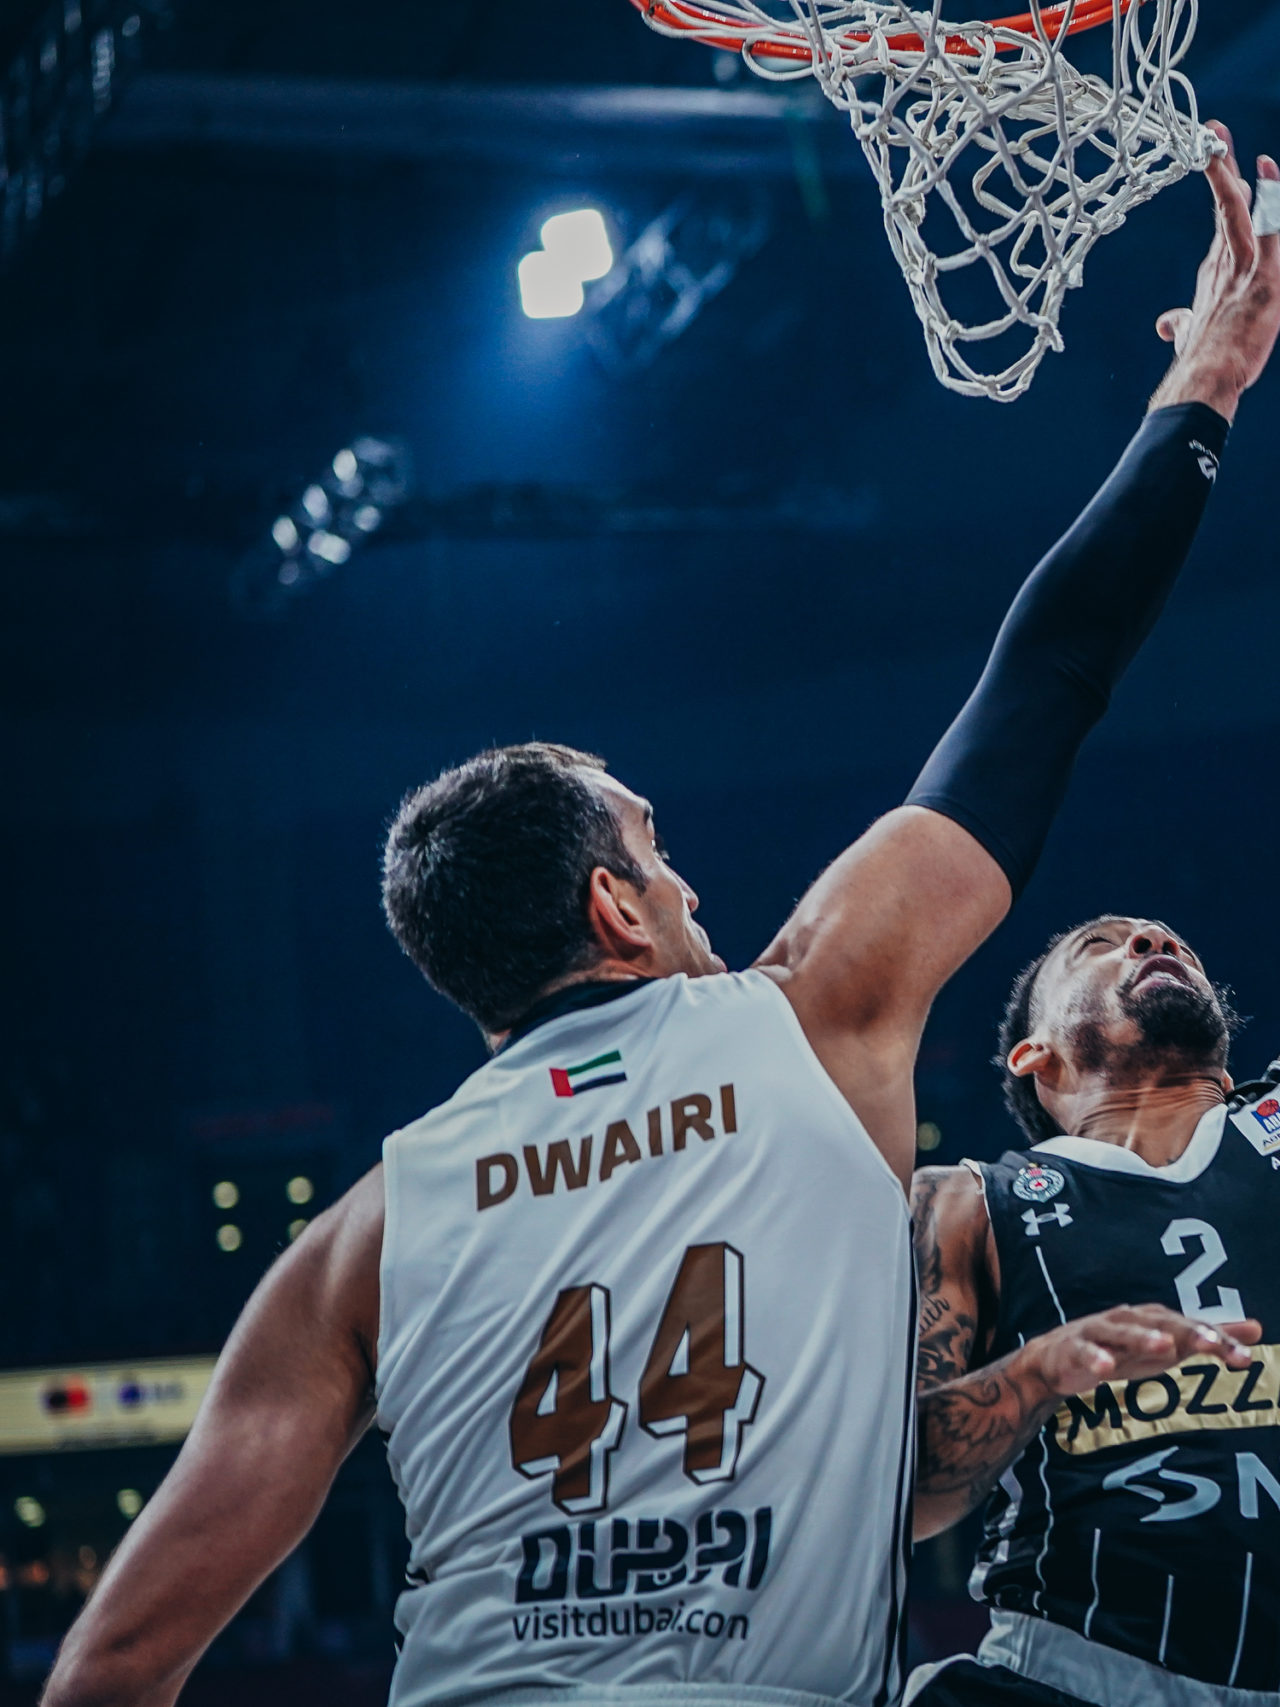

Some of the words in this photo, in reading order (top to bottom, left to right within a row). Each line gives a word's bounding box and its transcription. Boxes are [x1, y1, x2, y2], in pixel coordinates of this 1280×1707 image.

[476, 1083, 738, 1212] DWAIRI
[1160, 1217, 1247, 1325] 2
[509, 1241, 766, 1516] 44
